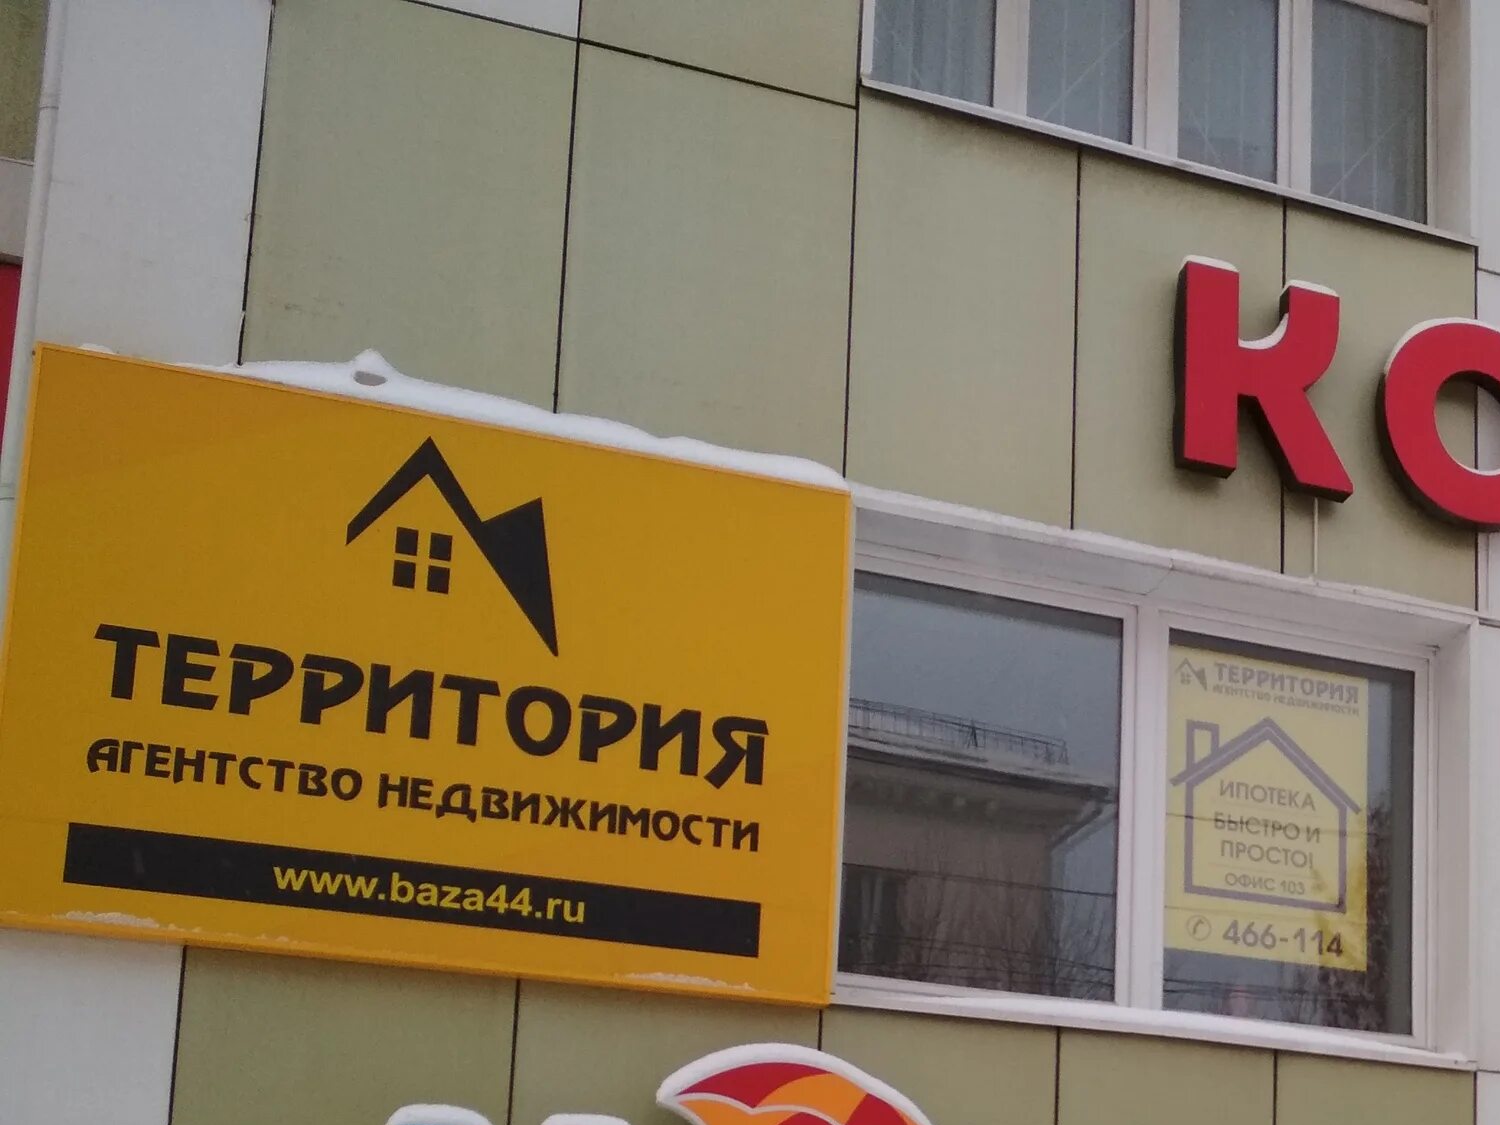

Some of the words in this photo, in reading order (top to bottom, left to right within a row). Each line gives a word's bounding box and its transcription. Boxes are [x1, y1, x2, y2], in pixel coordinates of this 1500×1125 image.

[1214, 662, 1359, 704] ТЕРРИТОРИЯ
[94, 623, 769, 789] ТЕРРИТОРИЯ
[86, 738, 362, 801] АГЕНТСТВО
[378, 774, 760, 852] НЕДВИЖИМОСТИ
[1219, 779, 1316, 811] ИПОТЕКА
[1213, 811, 1300, 842] БЫСТРО
[1305, 827, 1321, 844] И
[1220, 839, 1313, 869] ПРОСТО!
[273, 862, 586, 925] www.baza44.ru
[1225, 872, 1275, 892] ОФИС
[1280, 876, 1305, 896] 103
[1222, 919, 1344, 958] 466-114
